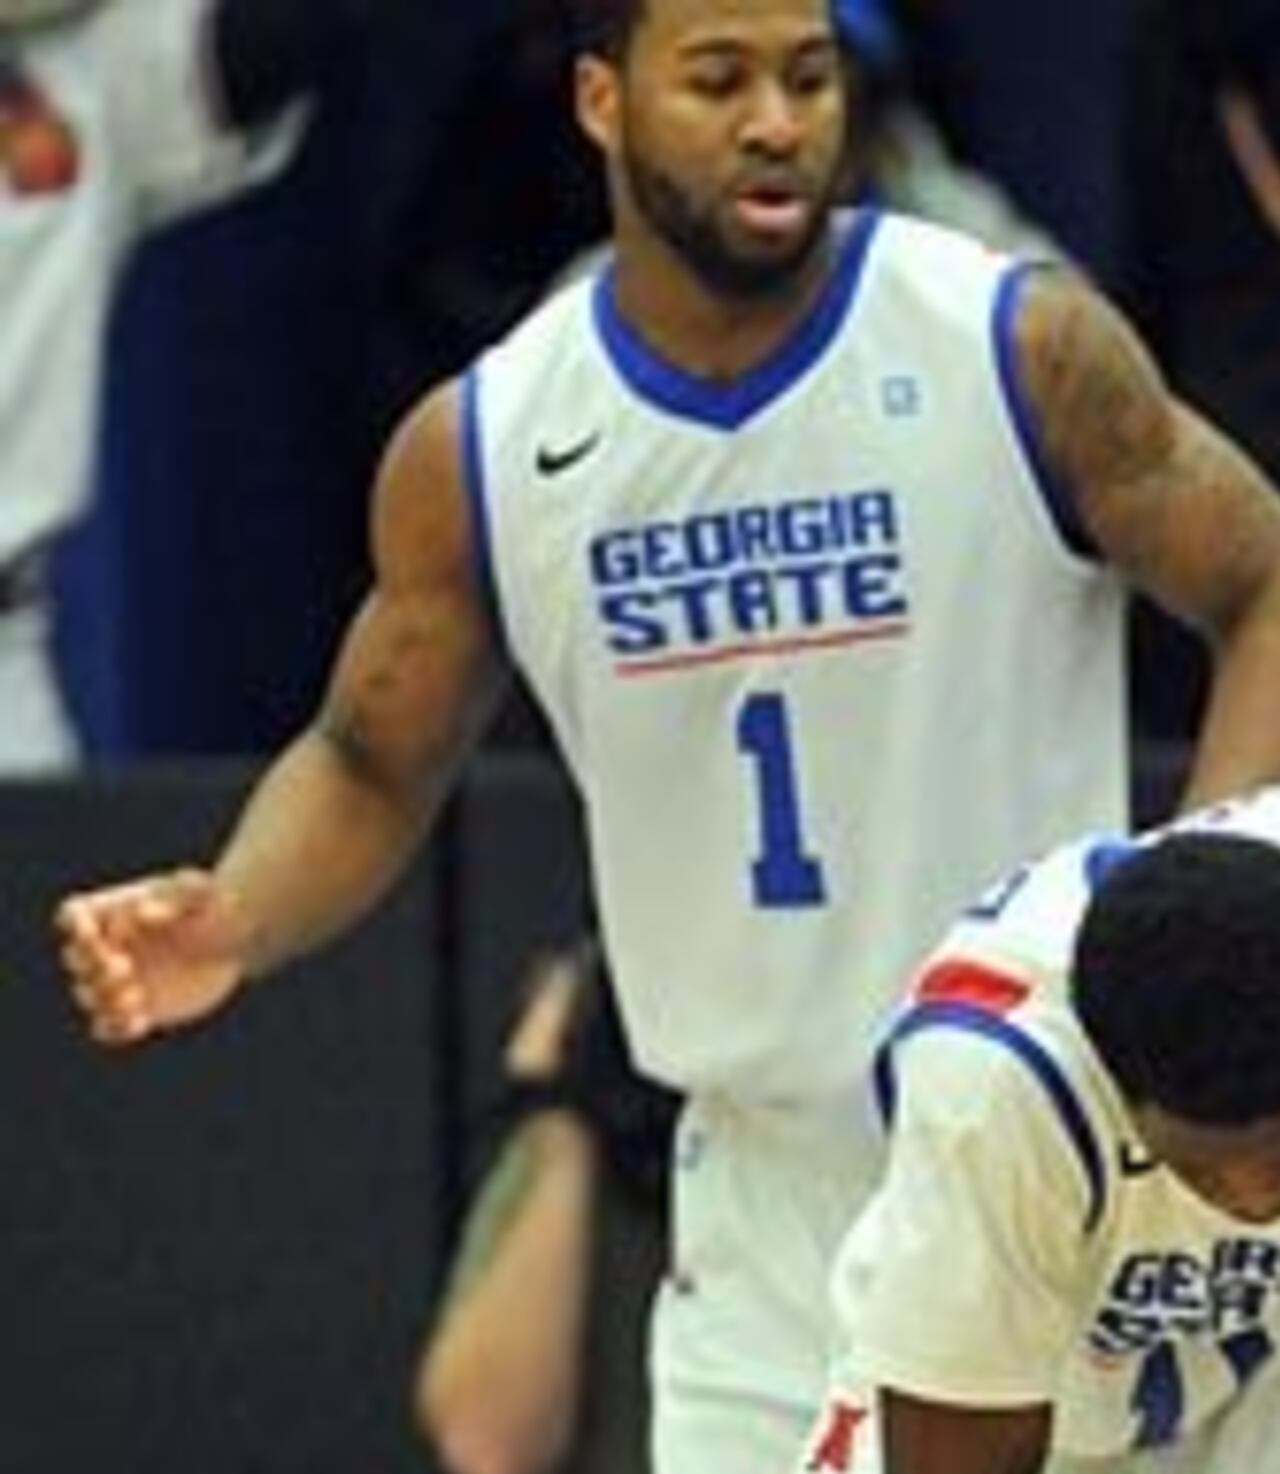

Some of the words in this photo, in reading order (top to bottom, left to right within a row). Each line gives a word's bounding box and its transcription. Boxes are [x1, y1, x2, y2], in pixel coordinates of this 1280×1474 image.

[589, 490, 896, 588] GEORGIA
[600, 555, 908, 655] STATE
[737, 693, 829, 907] 1
